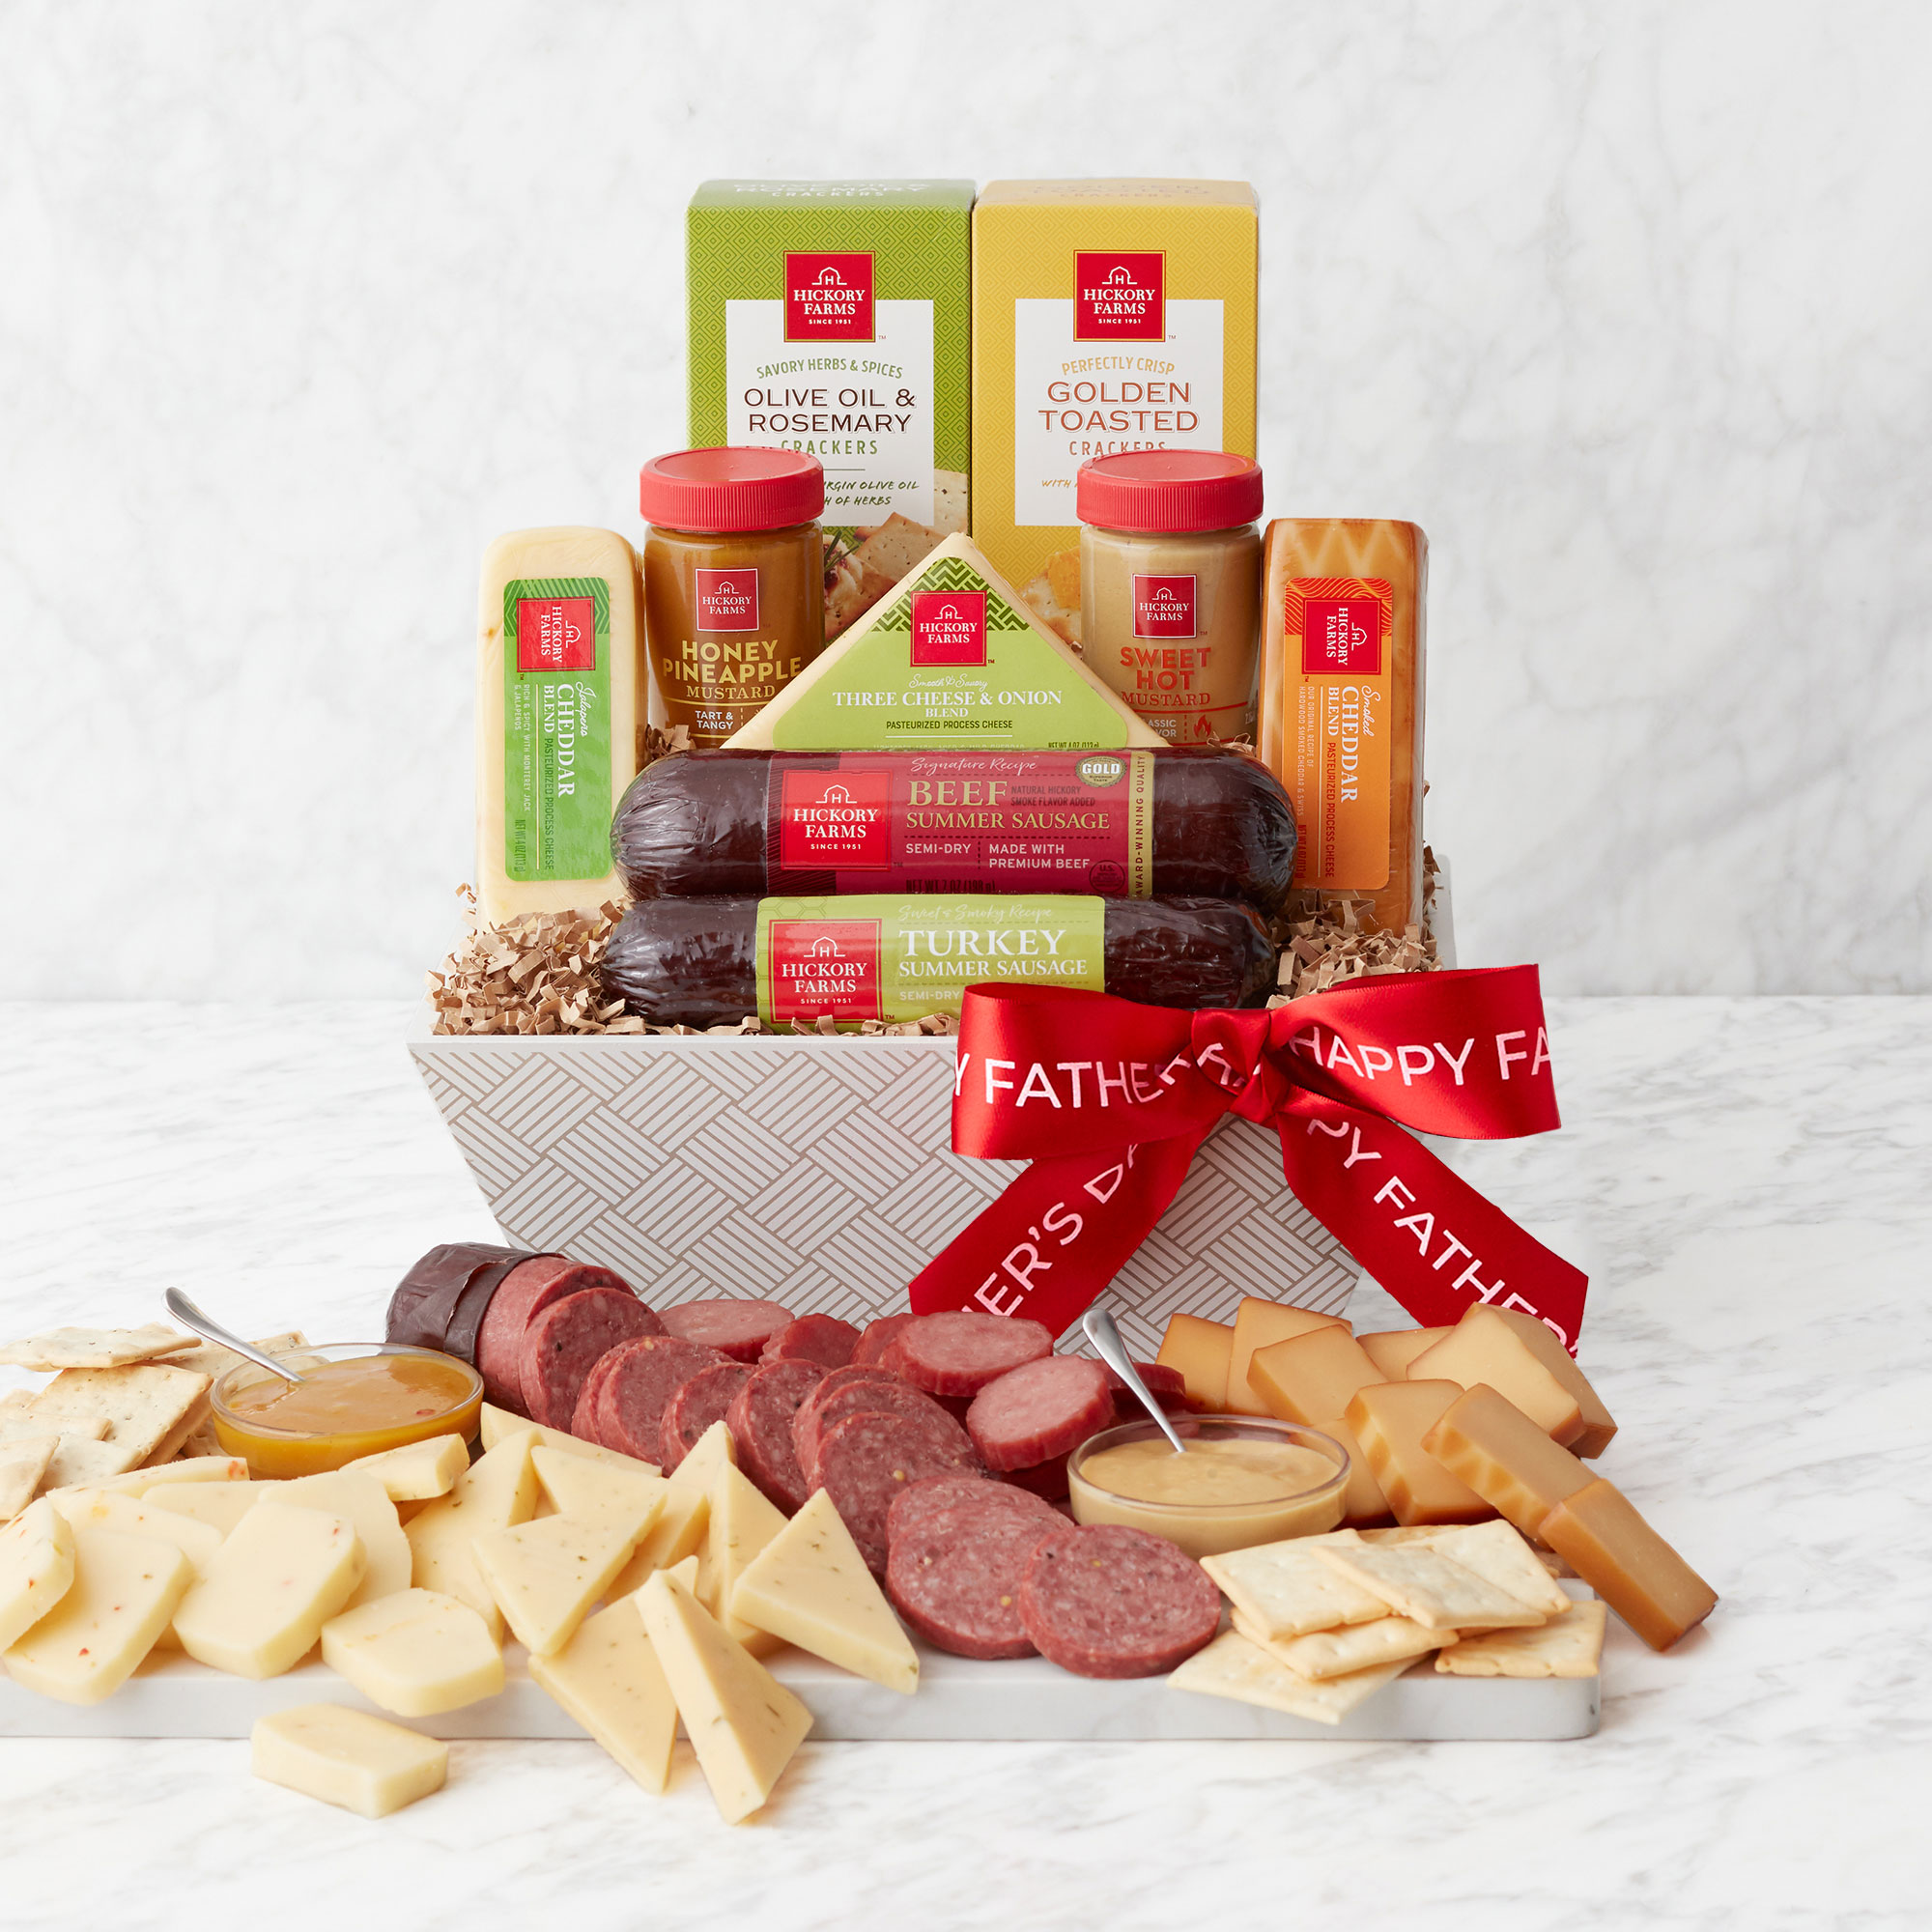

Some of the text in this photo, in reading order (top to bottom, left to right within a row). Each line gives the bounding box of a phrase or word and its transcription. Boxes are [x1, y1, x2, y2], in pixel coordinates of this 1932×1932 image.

[793, 290, 866, 301] HICKORY
[1083, 289, 1155, 300] HICKORY
[804, 303, 856, 315] FARMS
[1094, 302, 1146, 314] FARMS
[756, 357, 903, 379] SAVORY HERBS & SPICES
[1062, 356, 1176, 376] PERFECTLY CRISP
[744, 388, 916, 408] OLIVE OIL &
[1047, 382, 1190, 403] GOLDEN
[749, 413, 912, 433] ROSEMARY
[1038, 410, 1199, 432] TOASTED
[825, 481, 920, 492] RGIN OLIVE OIL
[1041, 479, 1072, 488] WITH
[835, 496, 850, 506] OF
[854, 496, 892, 506] HERBS
[702, 596, 752, 605] HICKORY
[1140, 602, 1190, 611] HICKORY
[709, 606, 746, 614] FARMS
[1146, 612, 1183, 621] FARMS
[552, 606, 562, 663] HICKORY
[920, 622, 978, 633] HICKORY
[541, 614, 551, 656] FARMS
[927, 634, 970, 643] FARMS
[1326, 615, 1337, 658] FARMS
[1338, 608, 1349, 666] HICKORY
[682, 639, 779, 663] HONEY
[1121, 646, 1211, 668] SWEET
[663, 657, 802, 684] PINEAPPLE
[909, 673, 945, 688] Smooth
[955, 673, 988, 692] Savory
[1136, 669, 1196, 690] HOT
[686, 685, 776, 699] MUSTARD
[833, 690, 1063, 706] THREE CHEESE & ONION
[1121, 691, 1210, 706] MUSTARD
[696, 710, 734, 721] TART &
[925, 708, 969, 718] BLEND
[1361, 685, 1381, 737] Smoked
[696, 720, 734, 730] TANGY
[886, 720, 1013, 729] PASTEURIZED PROCESS CHEESE
[1148, 719, 1177, 727] ASSIC
[557, 684, 575, 798] CHEDDAR
[1341, 686, 1359, 803] CHEDDAR
[911, 757, 1038, 776] Signature Recipe
[1082, 763, 1121, 774] GOLD
[544, 685, 554, 870] BLEND PASTEURIZED PROCESS CHEESE
[1136, 755, 1145, 793] QUALITY
[1011, 785, 1081, 794] NATURAL HICKORY
[1324, 687, 1340, 878] BLEND PASTEURIZED PROCESS CHEESE
[907, 781, 1008, 807] BEEF
[1010, 797, 1095, 807] SMOKE FLAVOR ADDED
[793, 809, 878, 822] HICKORY
[906, 812, 1110, 829] SUMMER SAUSAGE
[805, 825, 867, 838] FARMS
[906, 843, 971, 854] SEMI-DRY
[989, 844, 1065, 854] MADE WITH
[989, 858, 1090, 868] PREMIUM BEEF
[898, 904, 941, 921] Sweet
[955, 904, 1005, 924] Smoky
[1009, 904, 1052, 924] Recipe
[898, 929, 1066, 956] TURKEY
[781, 963, 867, 977] HICKORY
[898, 959, 1088, 978] SUMMER SAUSAGE
[795, 980, 857, 993] FARMS
[899, 991, 960, 1001] SEMI-DRY
[1290, 1027, 1475, 1086] HAPPY
